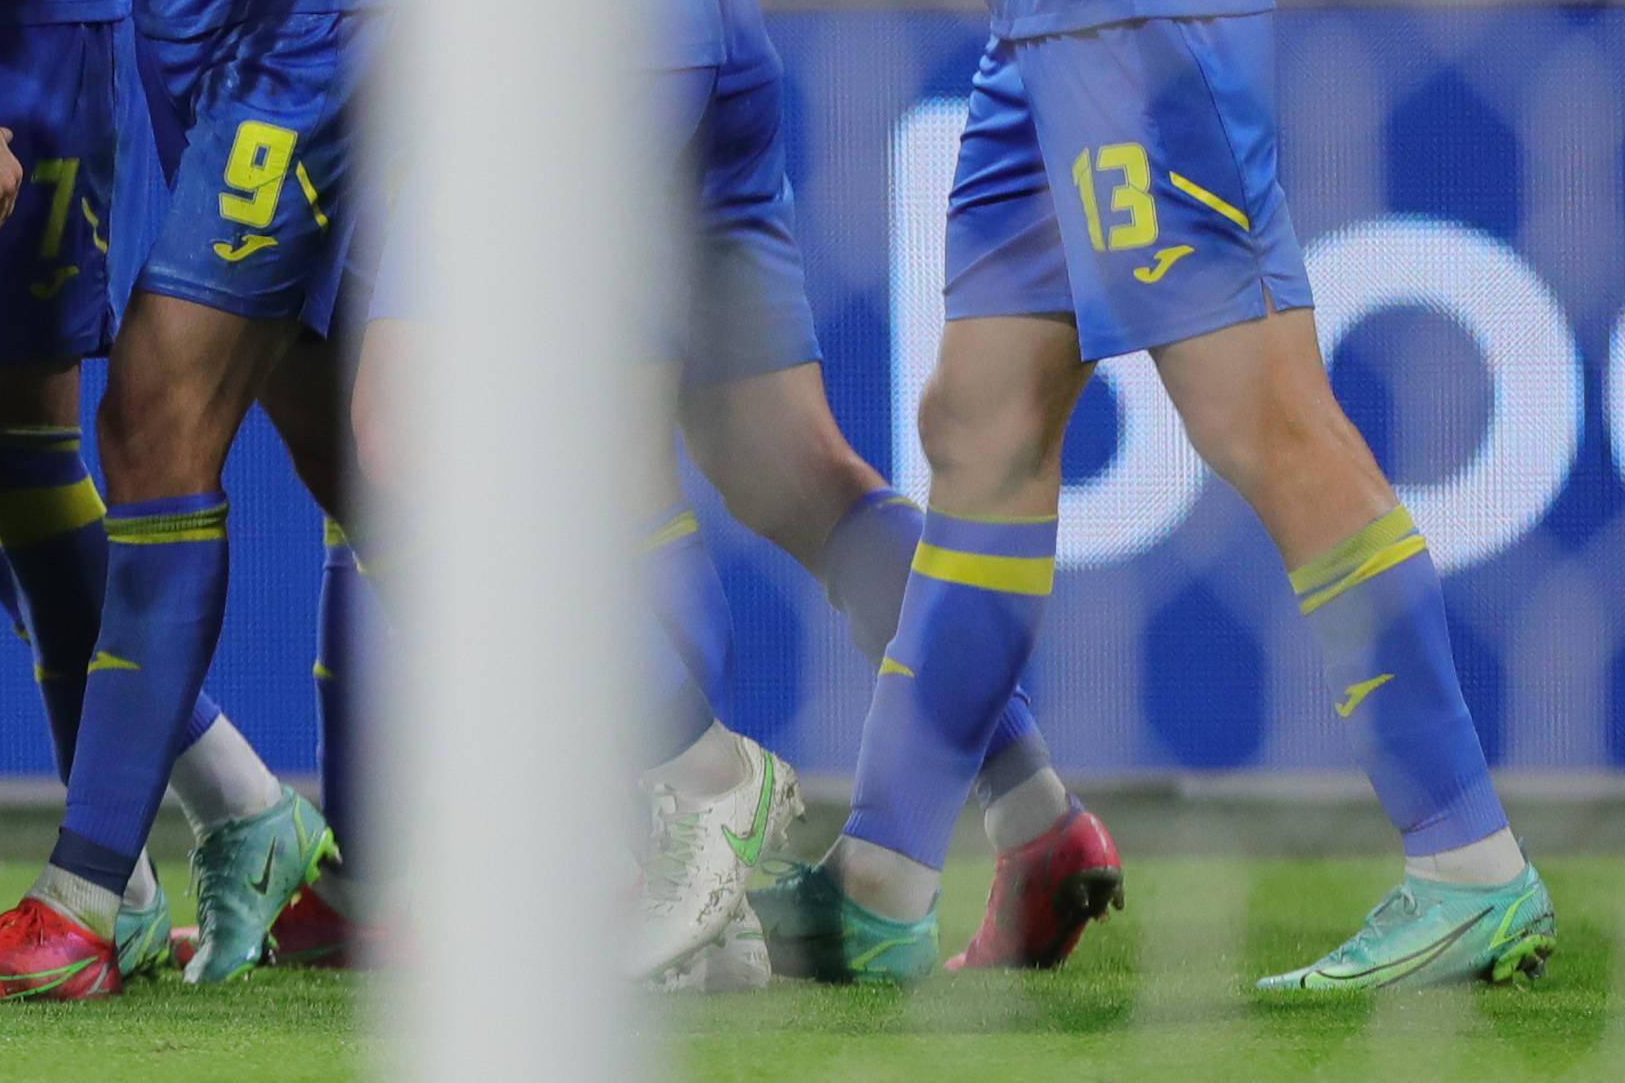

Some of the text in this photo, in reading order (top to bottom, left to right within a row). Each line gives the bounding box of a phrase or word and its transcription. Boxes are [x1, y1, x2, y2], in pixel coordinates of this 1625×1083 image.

[30, 157, 81, 258] 7
[218, 119, 299, 229] 9
[1071, 141, 1161, 253] 13
